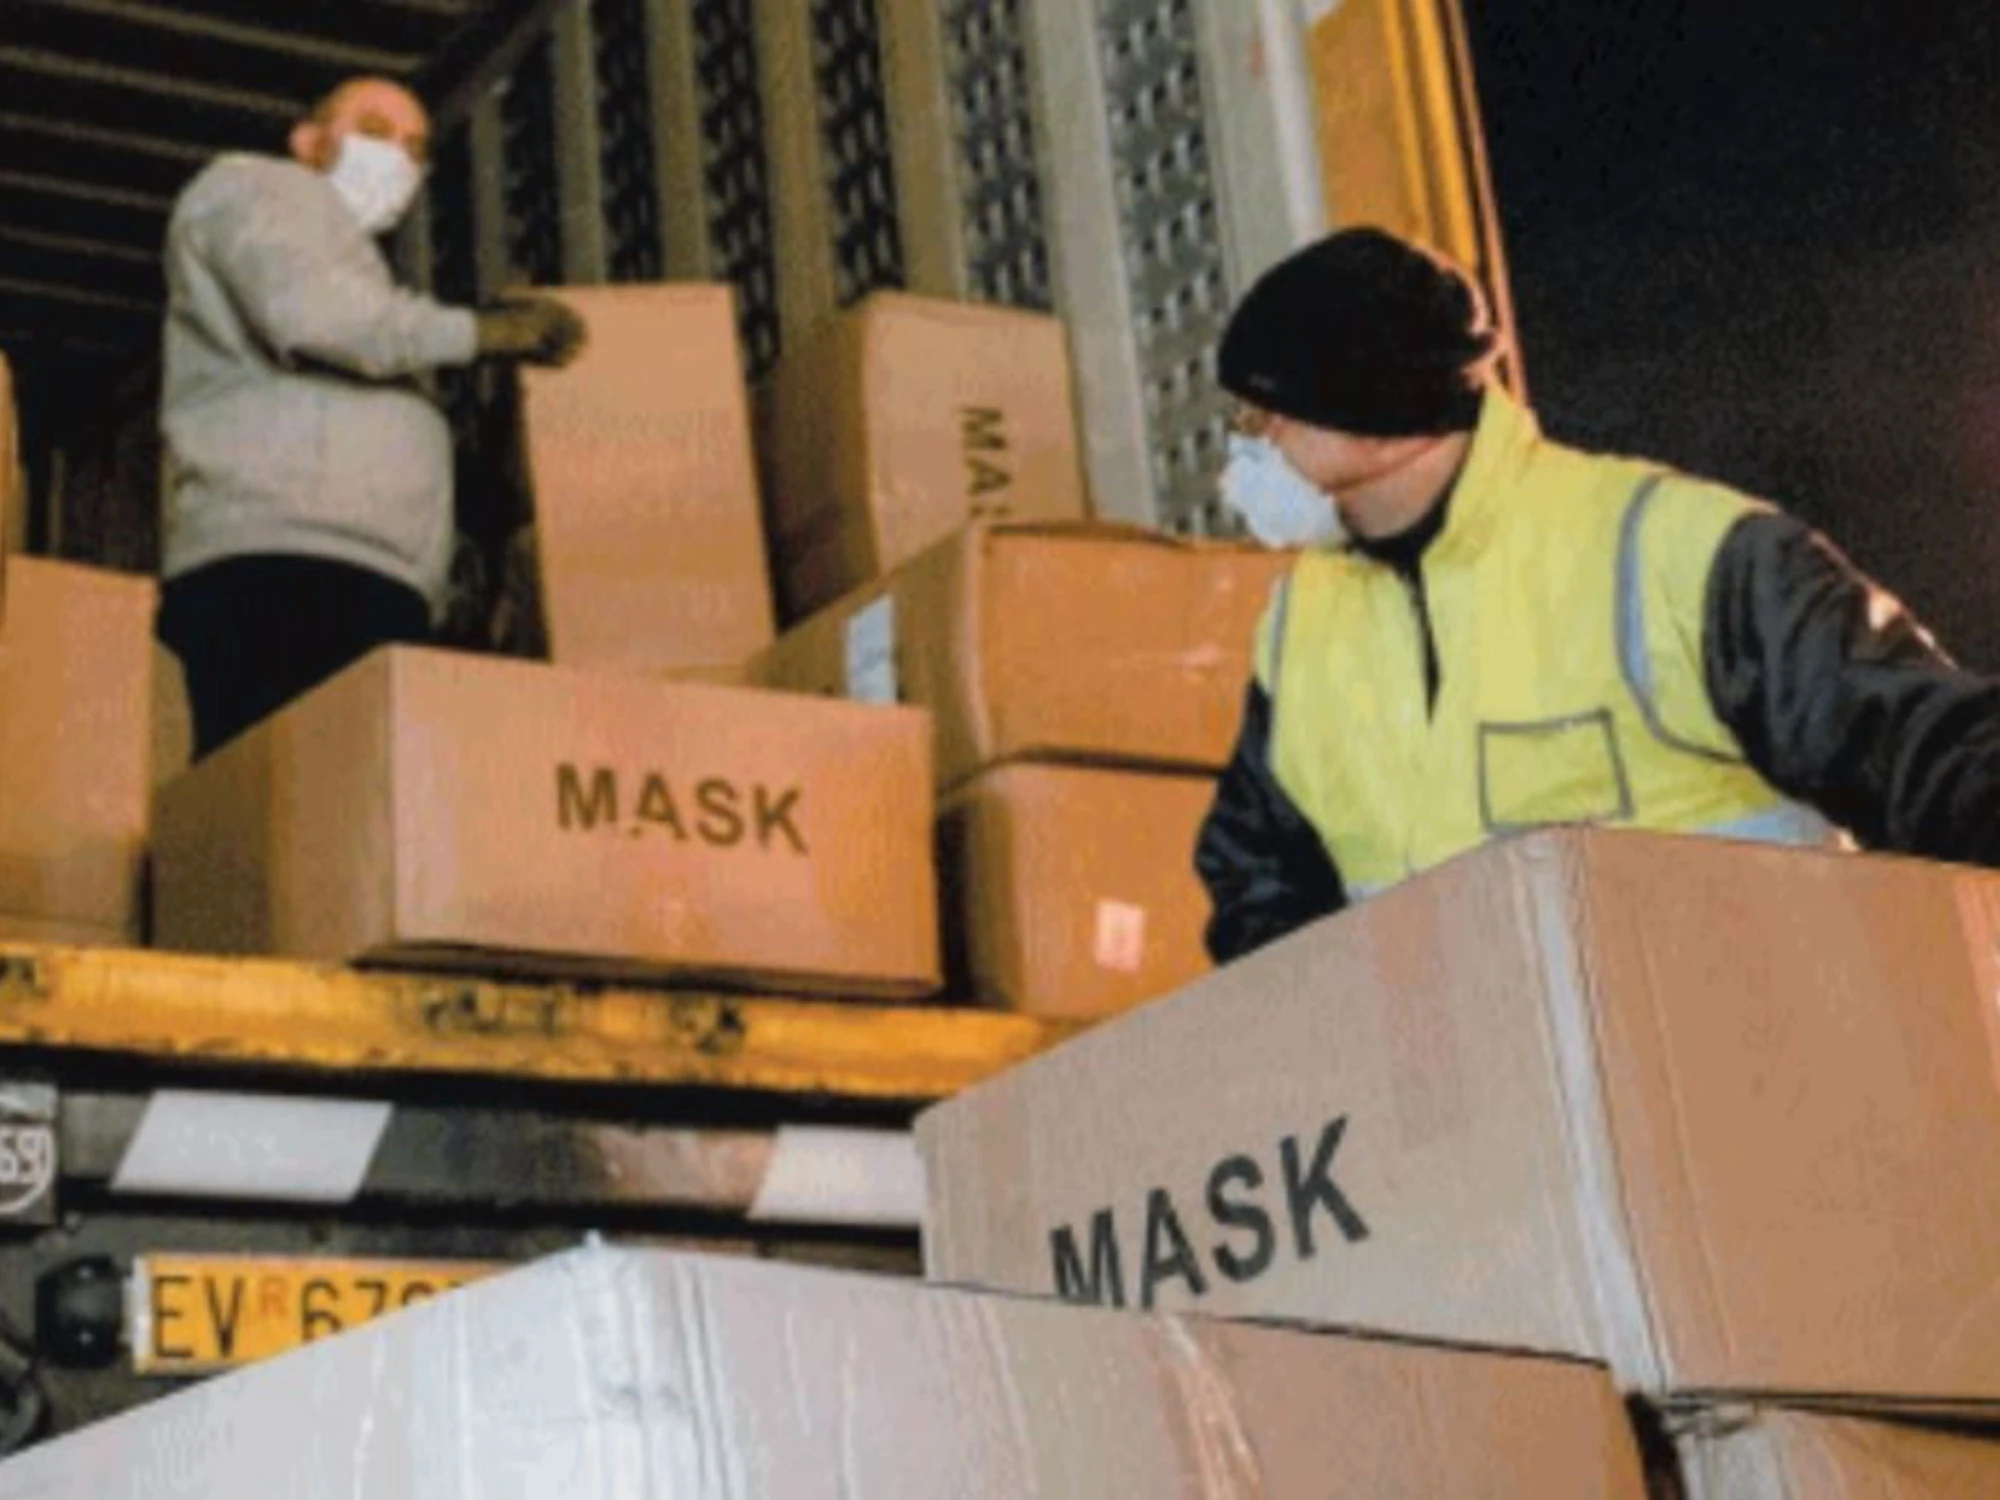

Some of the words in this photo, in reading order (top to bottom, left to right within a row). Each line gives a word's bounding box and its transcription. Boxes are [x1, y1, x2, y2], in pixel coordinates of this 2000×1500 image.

[962, 405, 1012, 518] MA
[555, 762, 808, 855] MASK
[1050, 1113, 1369, 1312] MASK
